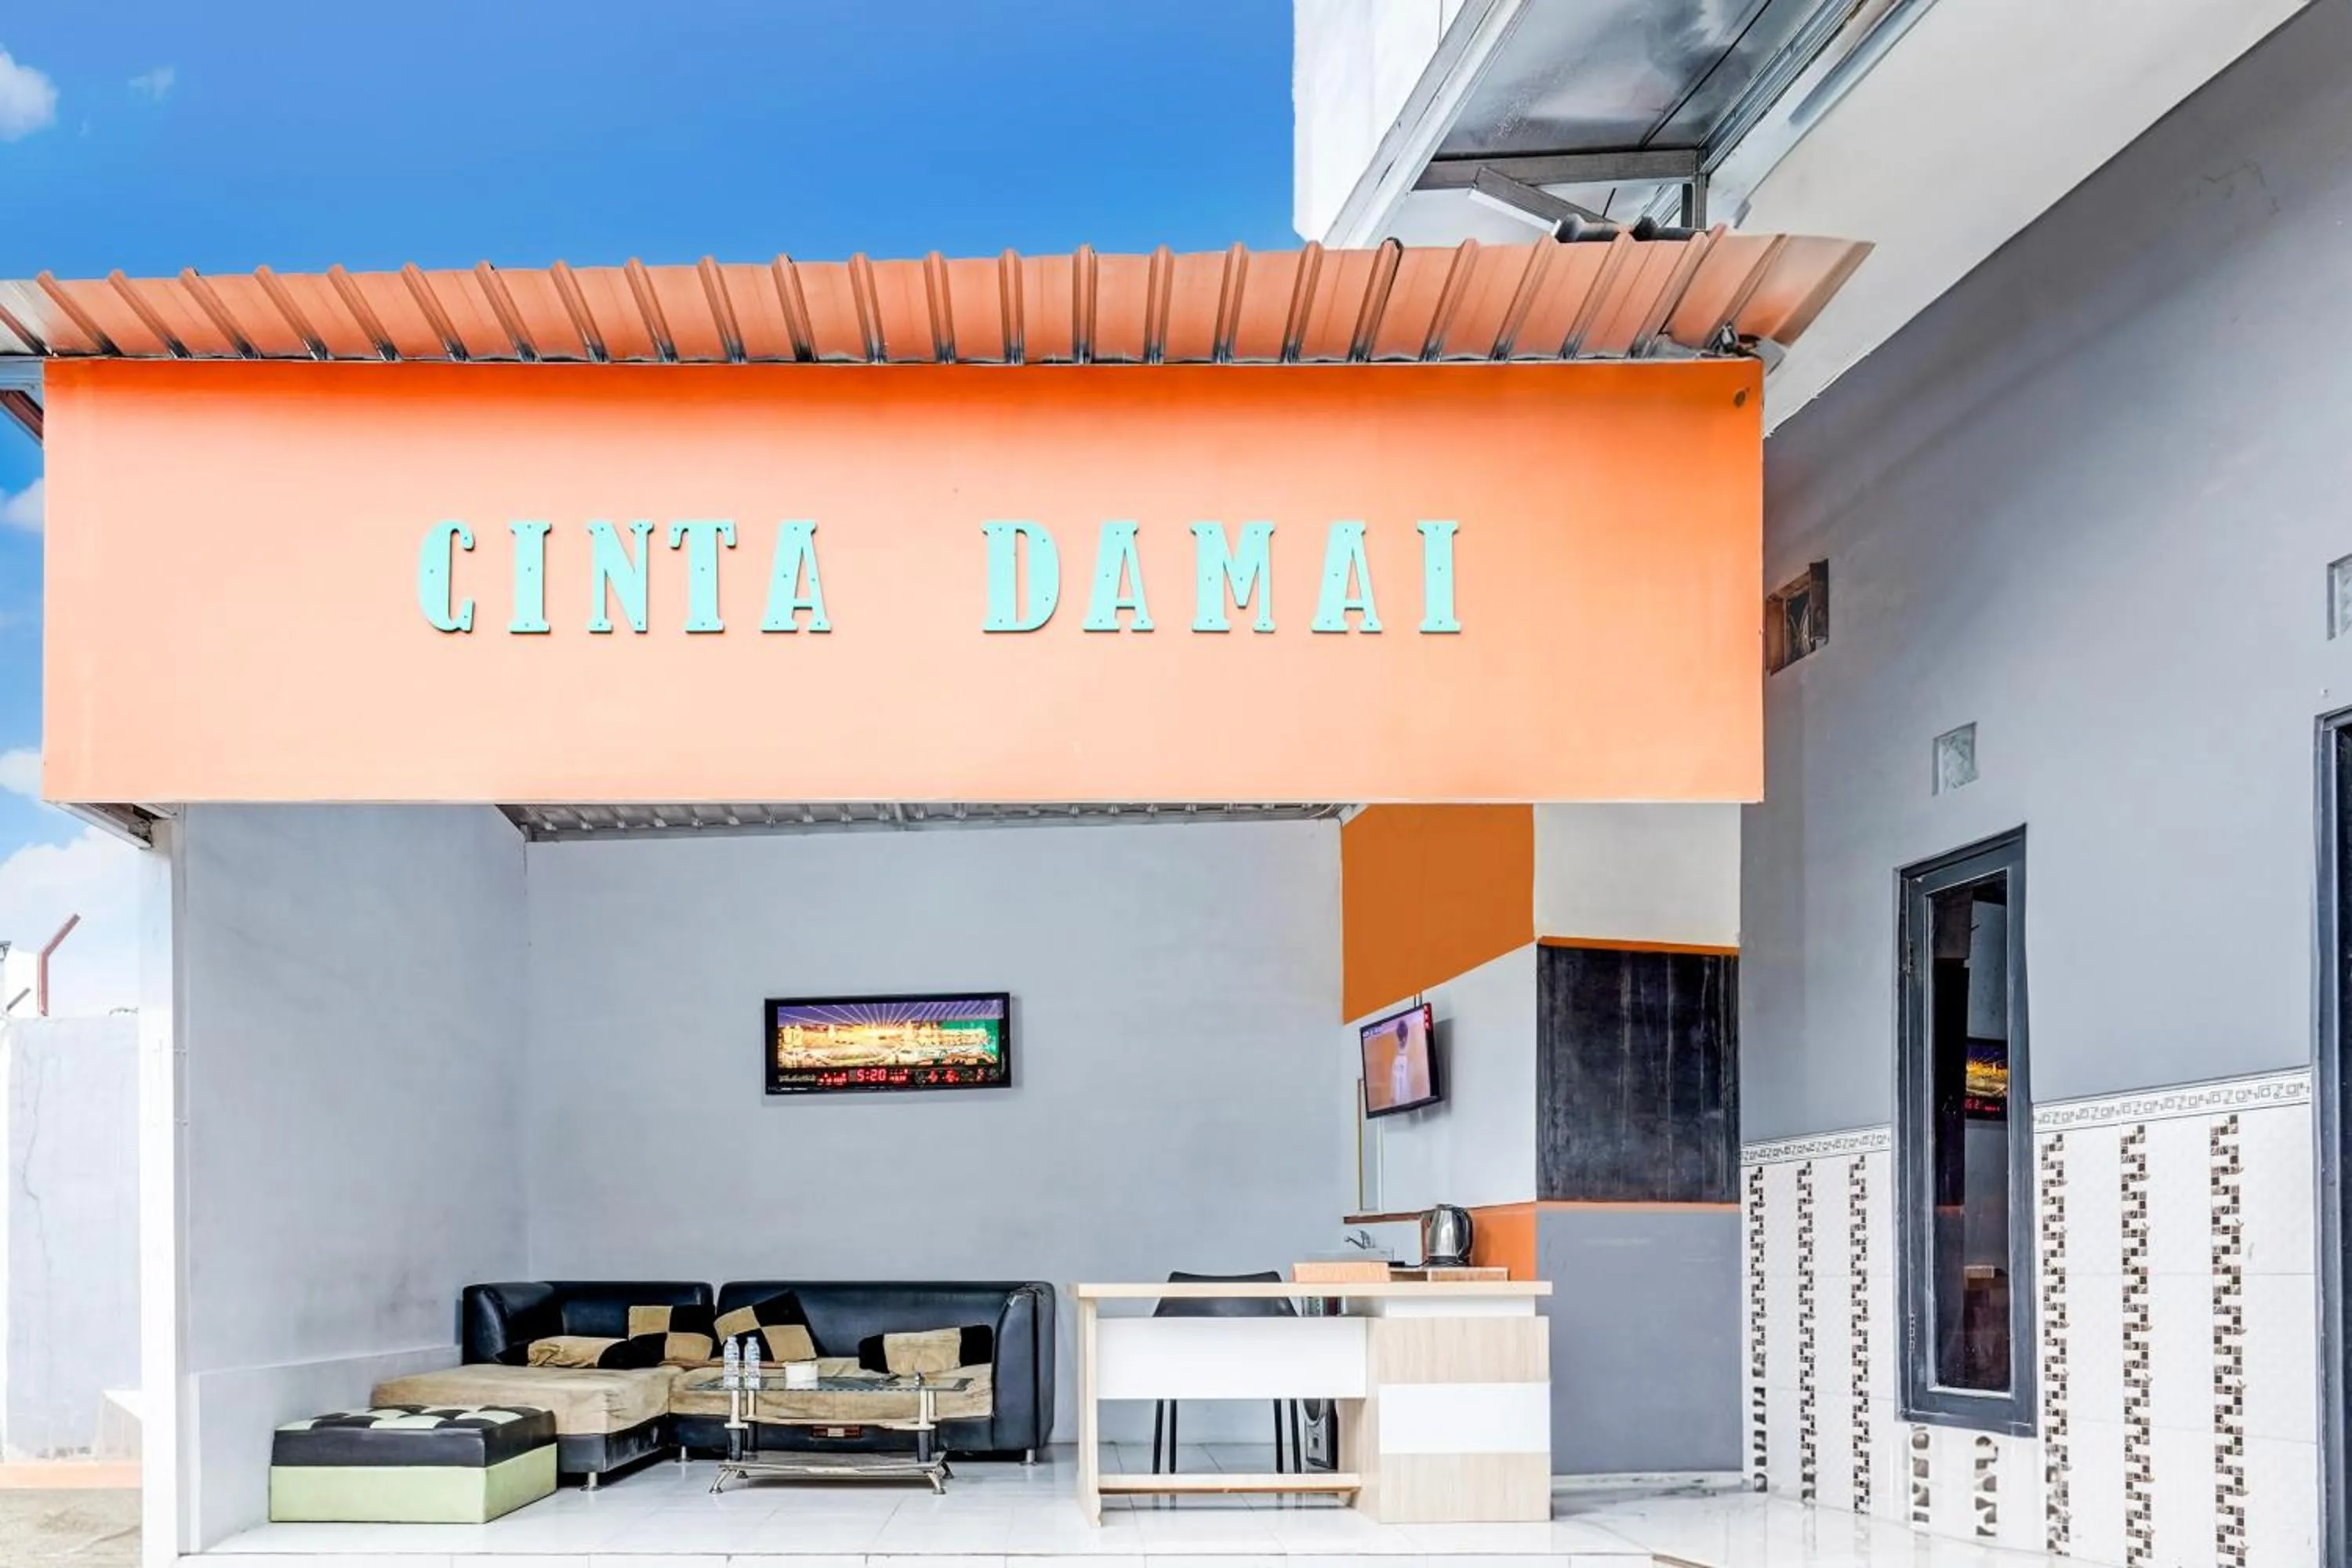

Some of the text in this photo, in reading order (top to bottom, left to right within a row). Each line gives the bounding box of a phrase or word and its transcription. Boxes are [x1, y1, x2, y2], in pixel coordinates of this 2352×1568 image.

[417, 520, 1461, 634] CINTA DAMAI
[856, 1069, 887, 1081] 5:20
